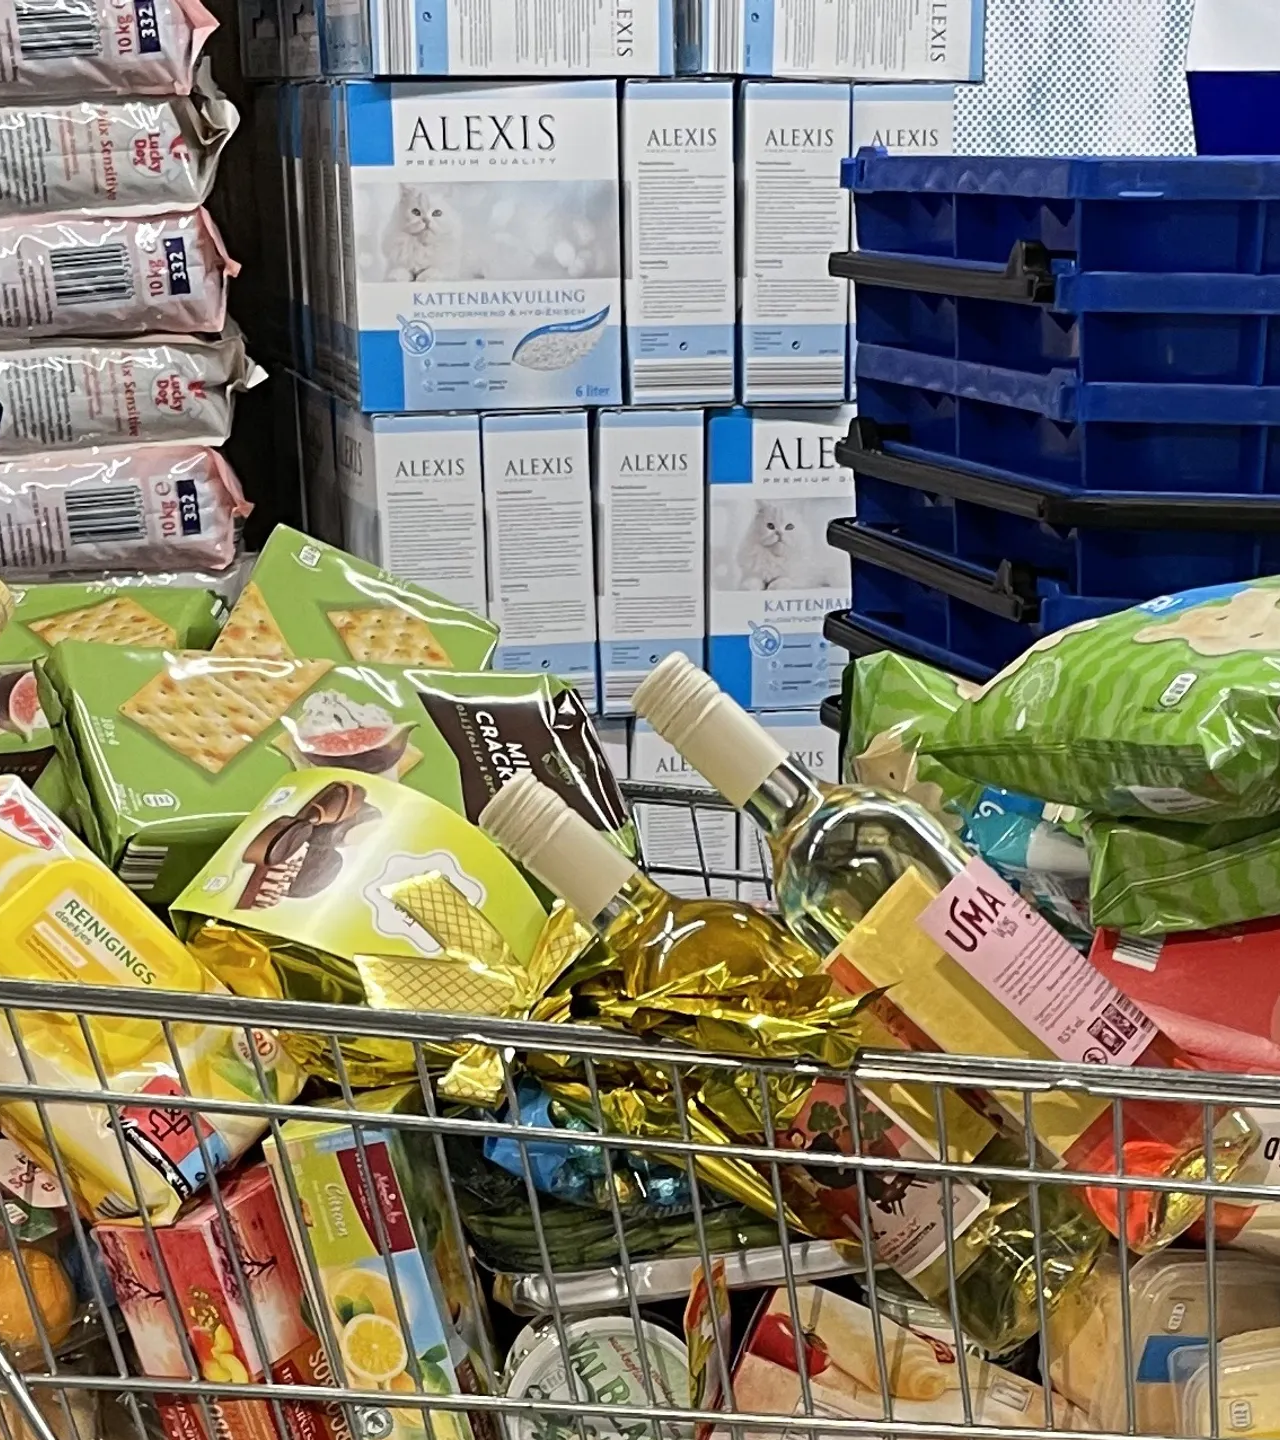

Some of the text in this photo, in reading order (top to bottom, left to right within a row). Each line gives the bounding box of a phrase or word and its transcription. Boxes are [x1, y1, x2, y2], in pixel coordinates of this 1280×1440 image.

[140, 6, 156, 39] 332
[616, 0, 633, 57] EXIS
[407, 113, 557, 152] ALEXIS
[647, 127, 717, 148] ALEXIS
[765, 128, 835, 148] ALEXIS
[872, 129, 939, 148] ALEXIS
[134, 138, 148, 167] Dog
[147, 131, 162, 174] Lucky
[170, 250, 187, 282] 332
[412, 289, 586, 306] KATTENBAKVULLING
[154, 378, 169, 407] Dog
[575, 385, 611, 398] 6 liter
[396, 458, 466, 478] ALEXIS
[504, 456, 574, 477] ALEXIS
[620, 453, 689, 473] ALEXIS
[183, 492, 198, 522] 332
[475, 710, 516, 786] CRACK
[506, 742, 533, 775] MI
[791, 750, 825, 767] XIS
[656, 757, 690, 773] ALE
[54, 910, 93, 947] doekjes
[945, 886, 1007, 953] UMA
[64, 898, 157, 986] REINIGINGS
